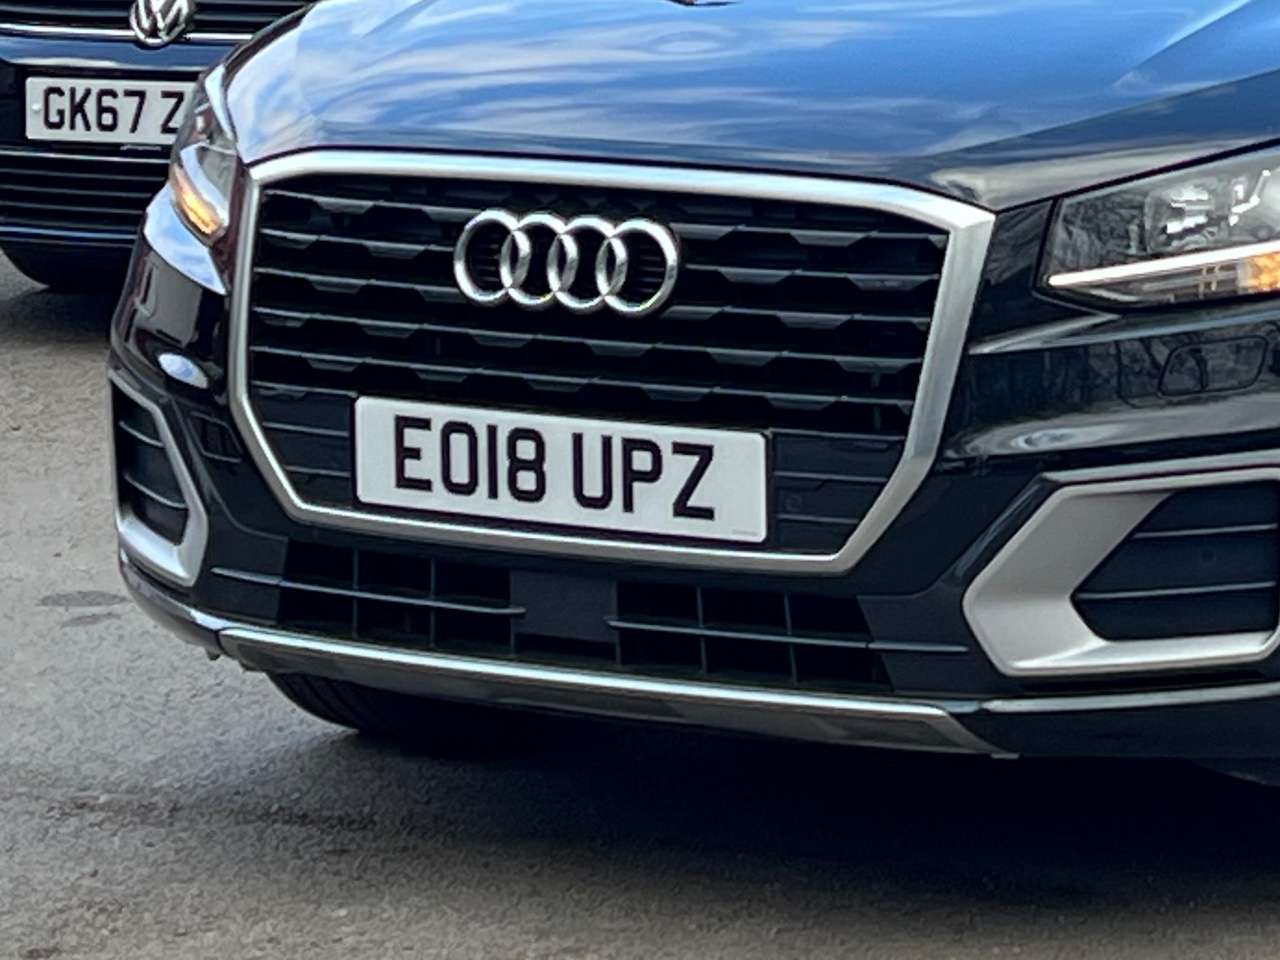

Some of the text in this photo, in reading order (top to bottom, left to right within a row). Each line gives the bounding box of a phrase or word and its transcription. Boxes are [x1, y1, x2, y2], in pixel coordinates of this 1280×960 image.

[43, 86, 147, 134] GK67
[394, 414, 715, 522] EO18 UPZ
